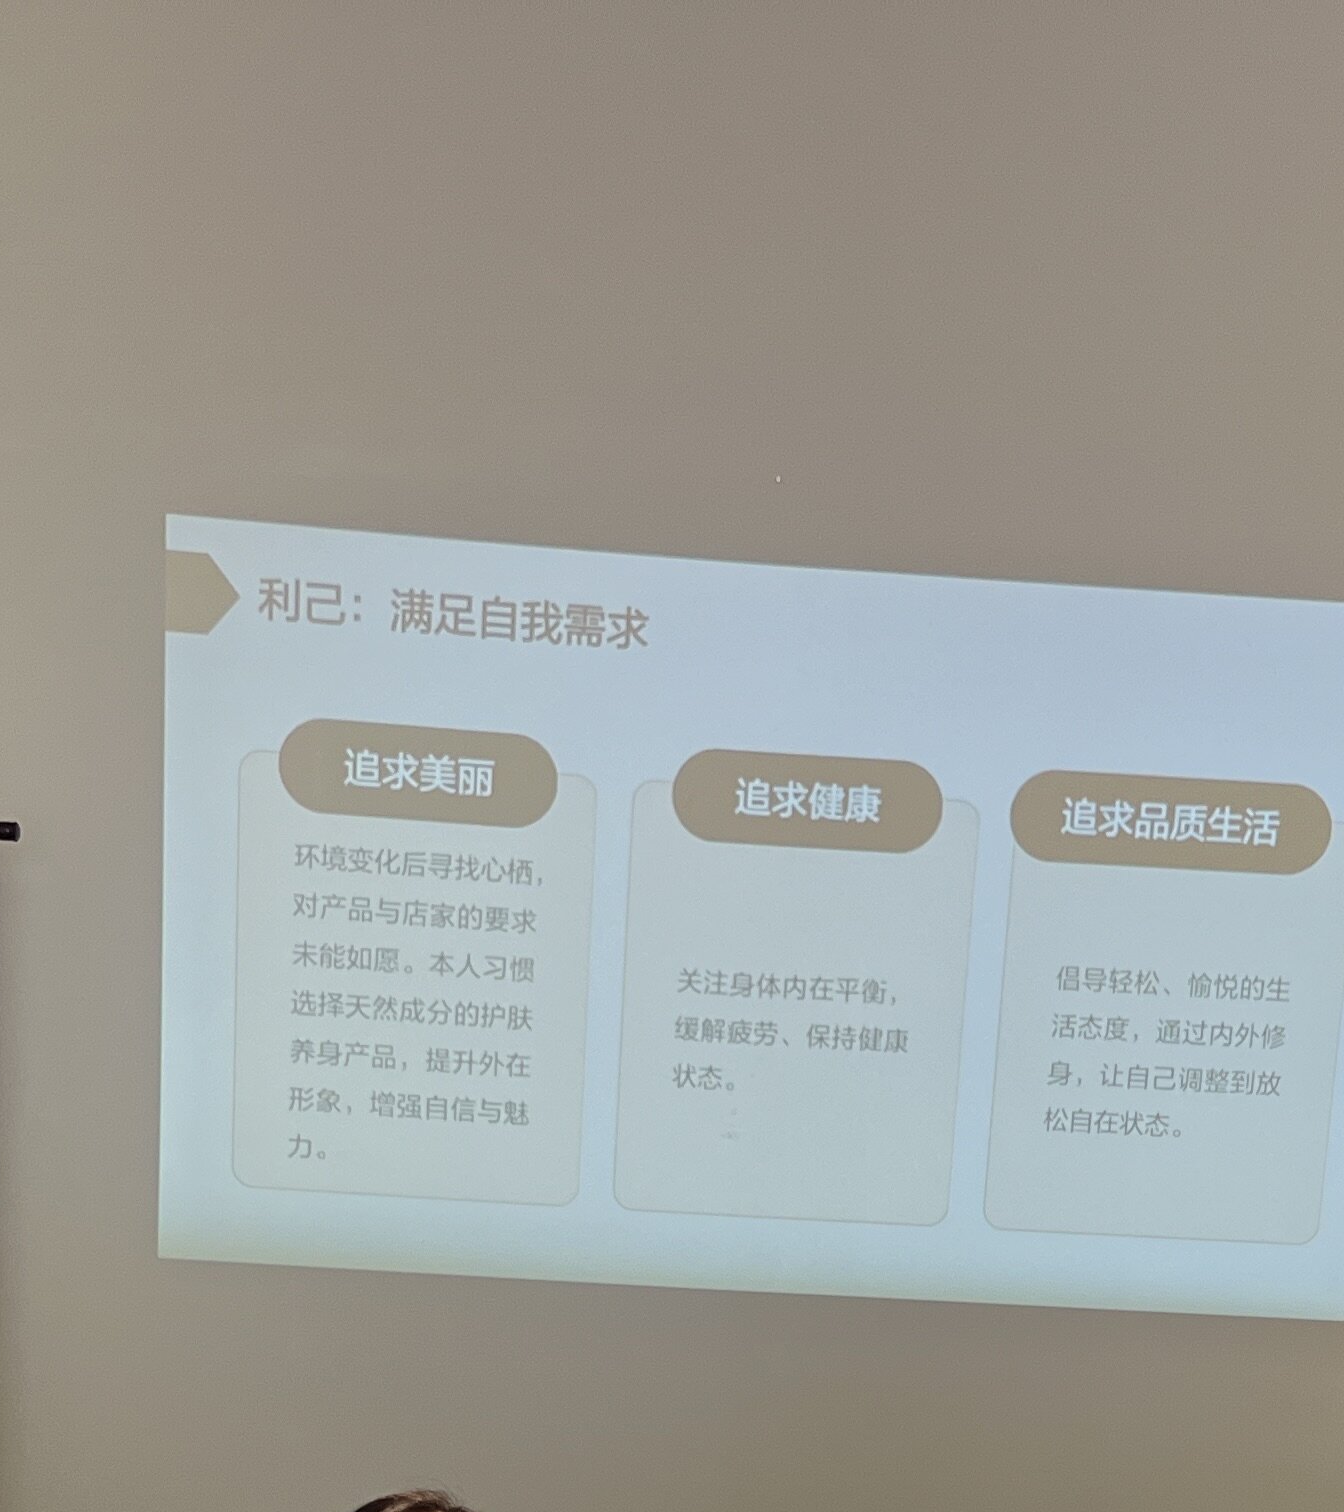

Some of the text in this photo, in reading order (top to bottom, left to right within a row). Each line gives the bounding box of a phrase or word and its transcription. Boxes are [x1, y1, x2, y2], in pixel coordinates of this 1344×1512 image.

[343, 748, 496, 798] 追求美丽
[734, 777, 882, 824] 追求健康
[1060, 796, 1281, 847] 追求品质生活
[292, 892, 538, 934] 对产品与店家的要求
[291, 940, 535, 984] 未能如愿。本人习惯
[1056, 965, 1291, 1003] 倡导轻松、愉悦的生
[290, 988, 533, 1032] 选择天然成分的护肤
[674, 1015, 909, 1054] 缓解疲劳、保持健康
[1050, 1013, 1287, 1050] 活态度，通过内外修
[289, 1038, 532, 1079] 养身产品，提升外在
[671, 1062, 736, 1093] 状态。
[1046, 1061, 1282, 1097] 身，让自己调整到放
[288, 1085, 530, 1127] 形象，增强自信与魅
[1043, 1106, 1187, 1139] 松自在状态。
